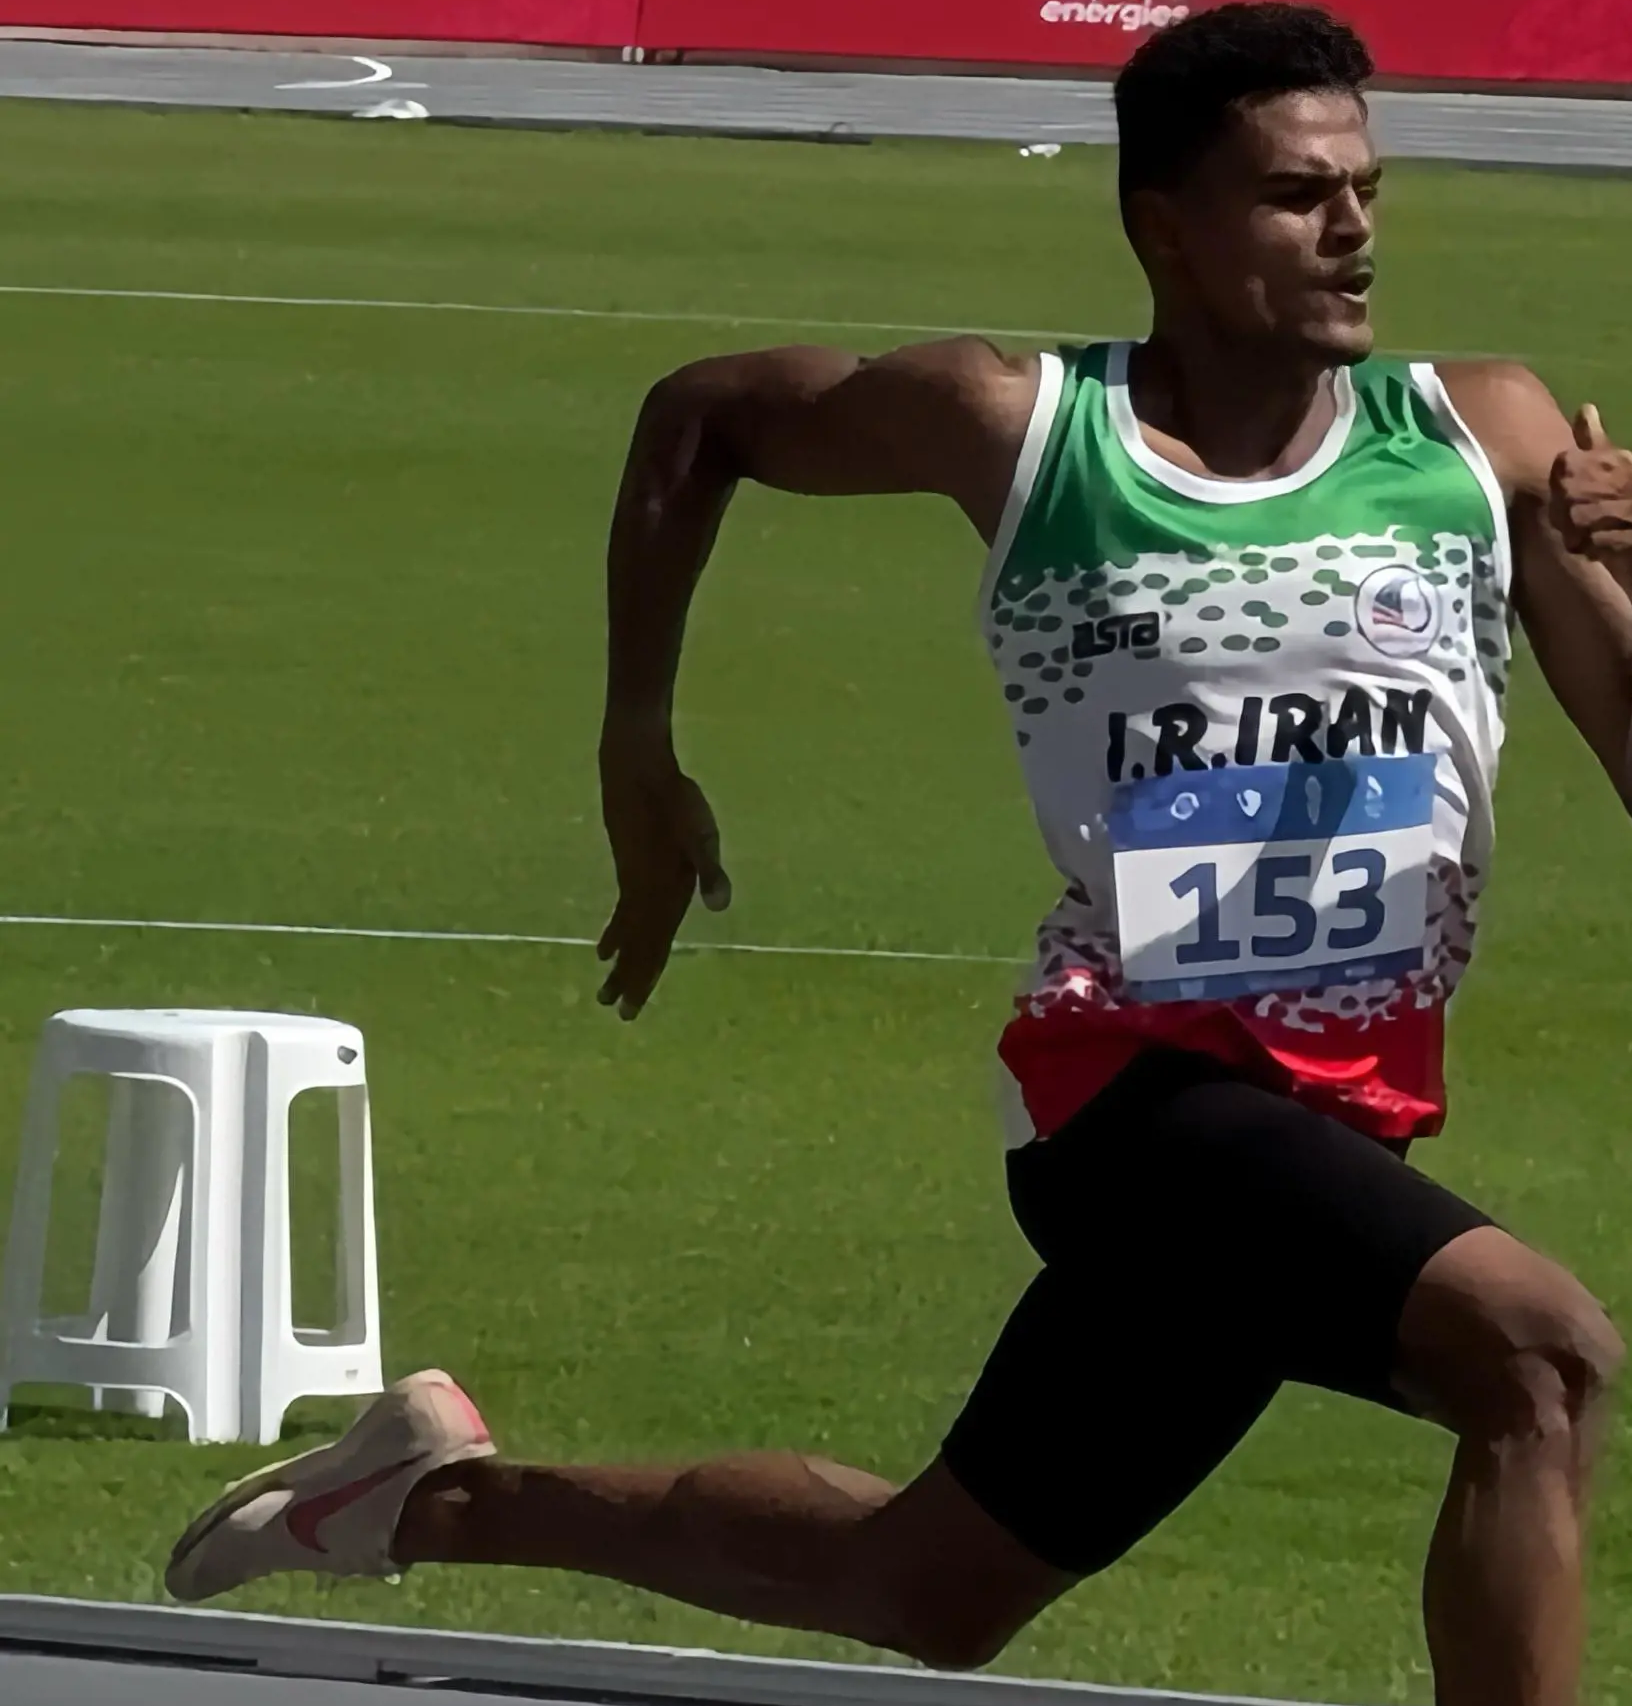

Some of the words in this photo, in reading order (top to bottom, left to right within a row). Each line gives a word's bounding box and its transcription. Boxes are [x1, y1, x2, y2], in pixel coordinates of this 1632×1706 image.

[1040, 0, 1190, 31] energies
[1106, 687, 1433, 783] I.R.IRAN
[1168, 848, 1387, 965] 153
